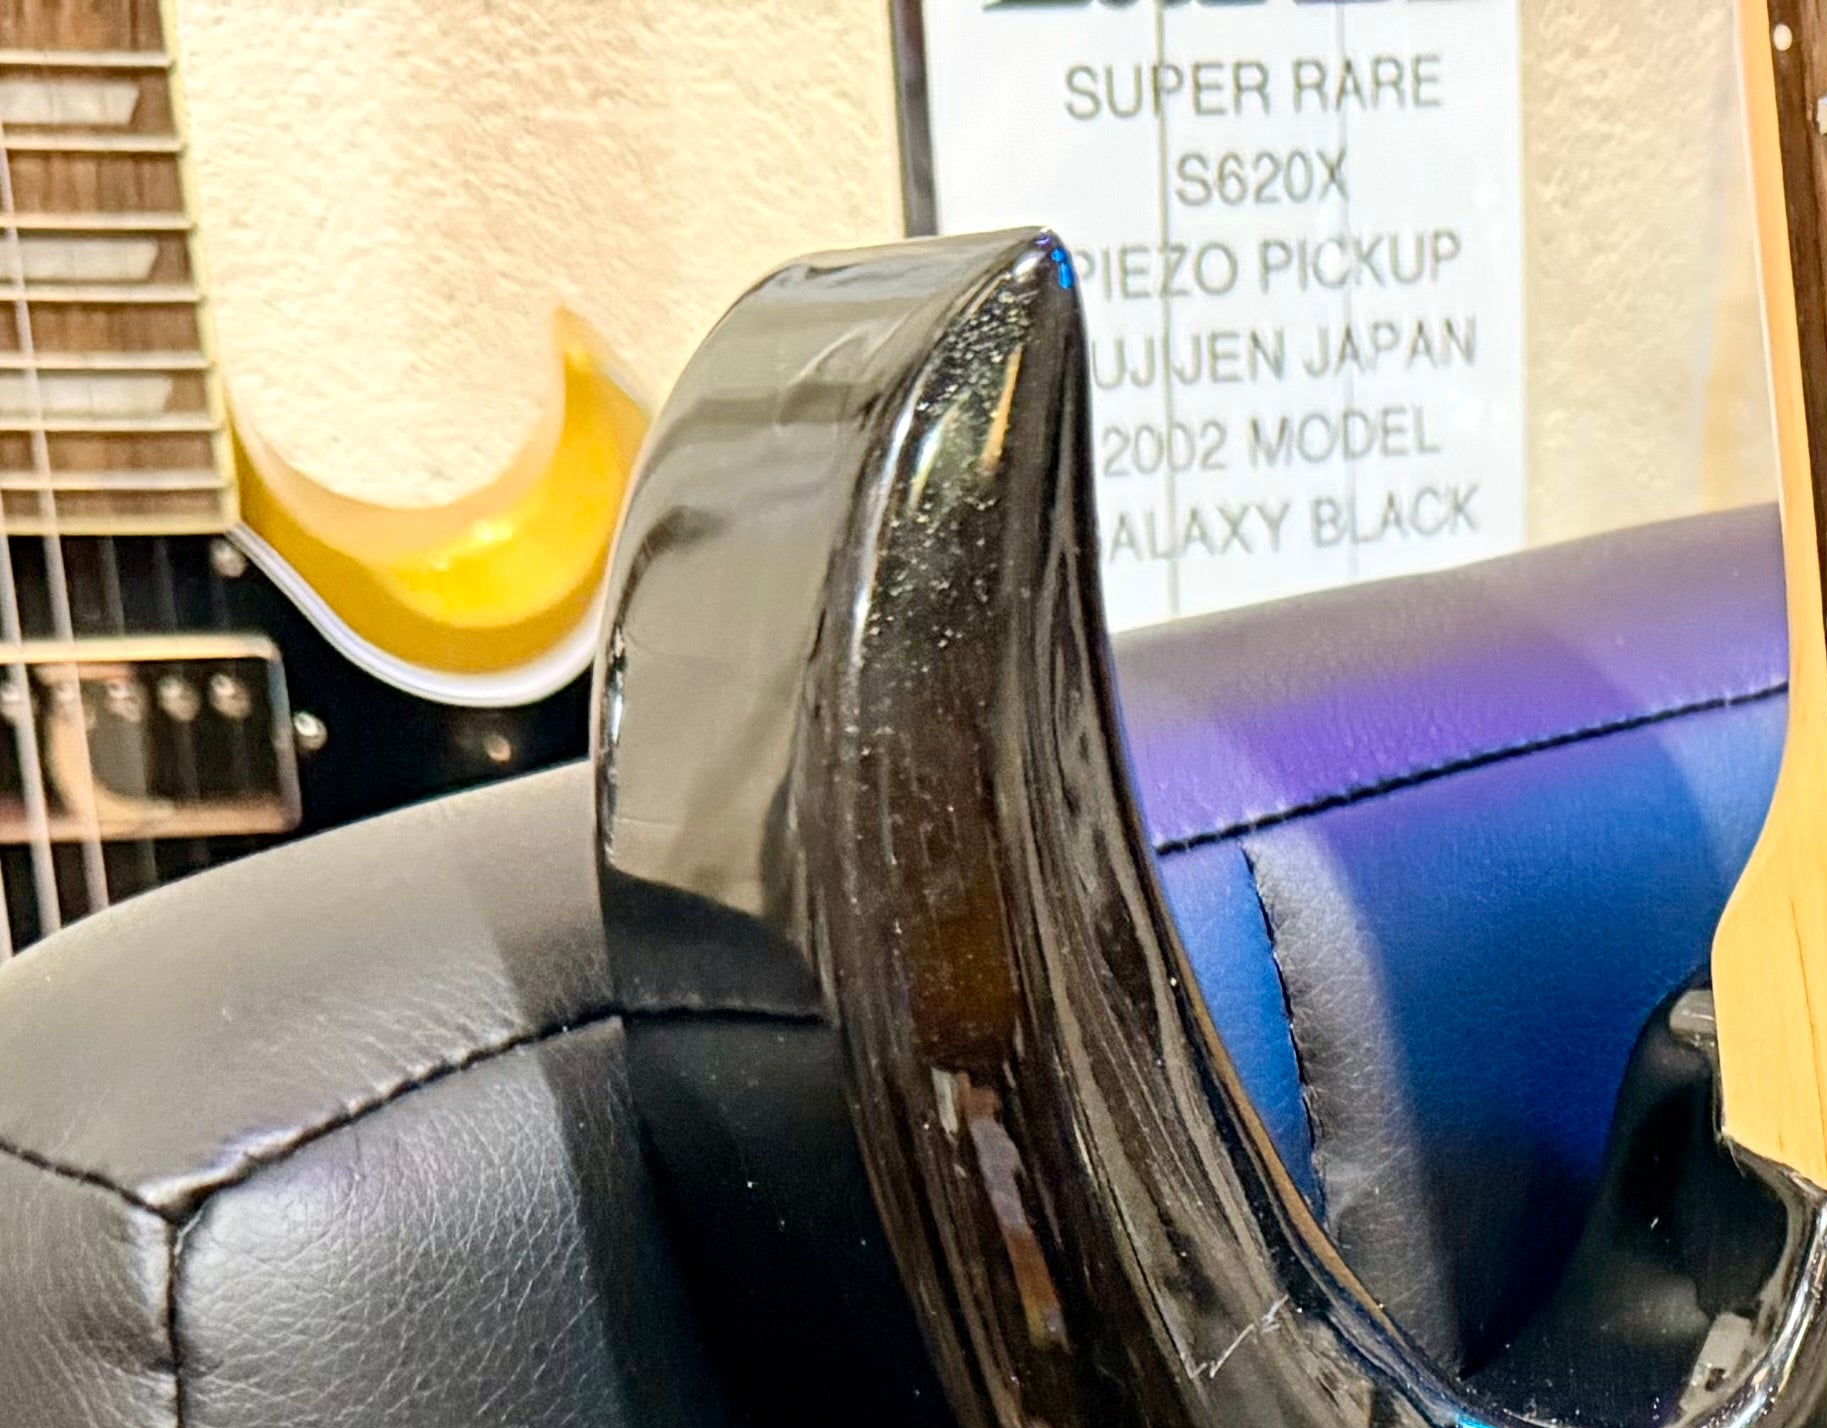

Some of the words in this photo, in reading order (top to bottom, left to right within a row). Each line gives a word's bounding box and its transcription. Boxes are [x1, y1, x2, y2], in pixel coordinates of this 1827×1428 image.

[1064, 61, 1272, 121] SUPER
[1291, 54, 1443, 114] RARE
[1175, 148, 1348, 206] S620X
[1258, 230, 1461, 295] PICKUP
[1302, 316, 1476, 378] JAPAN
[1103, 419, 1228, 477] 2002
[1249, 405, 1442, 467] MODEL
[1108, 502, 1290, 565] ALAXY
[1311, 485, 1481, 549] BLACK
